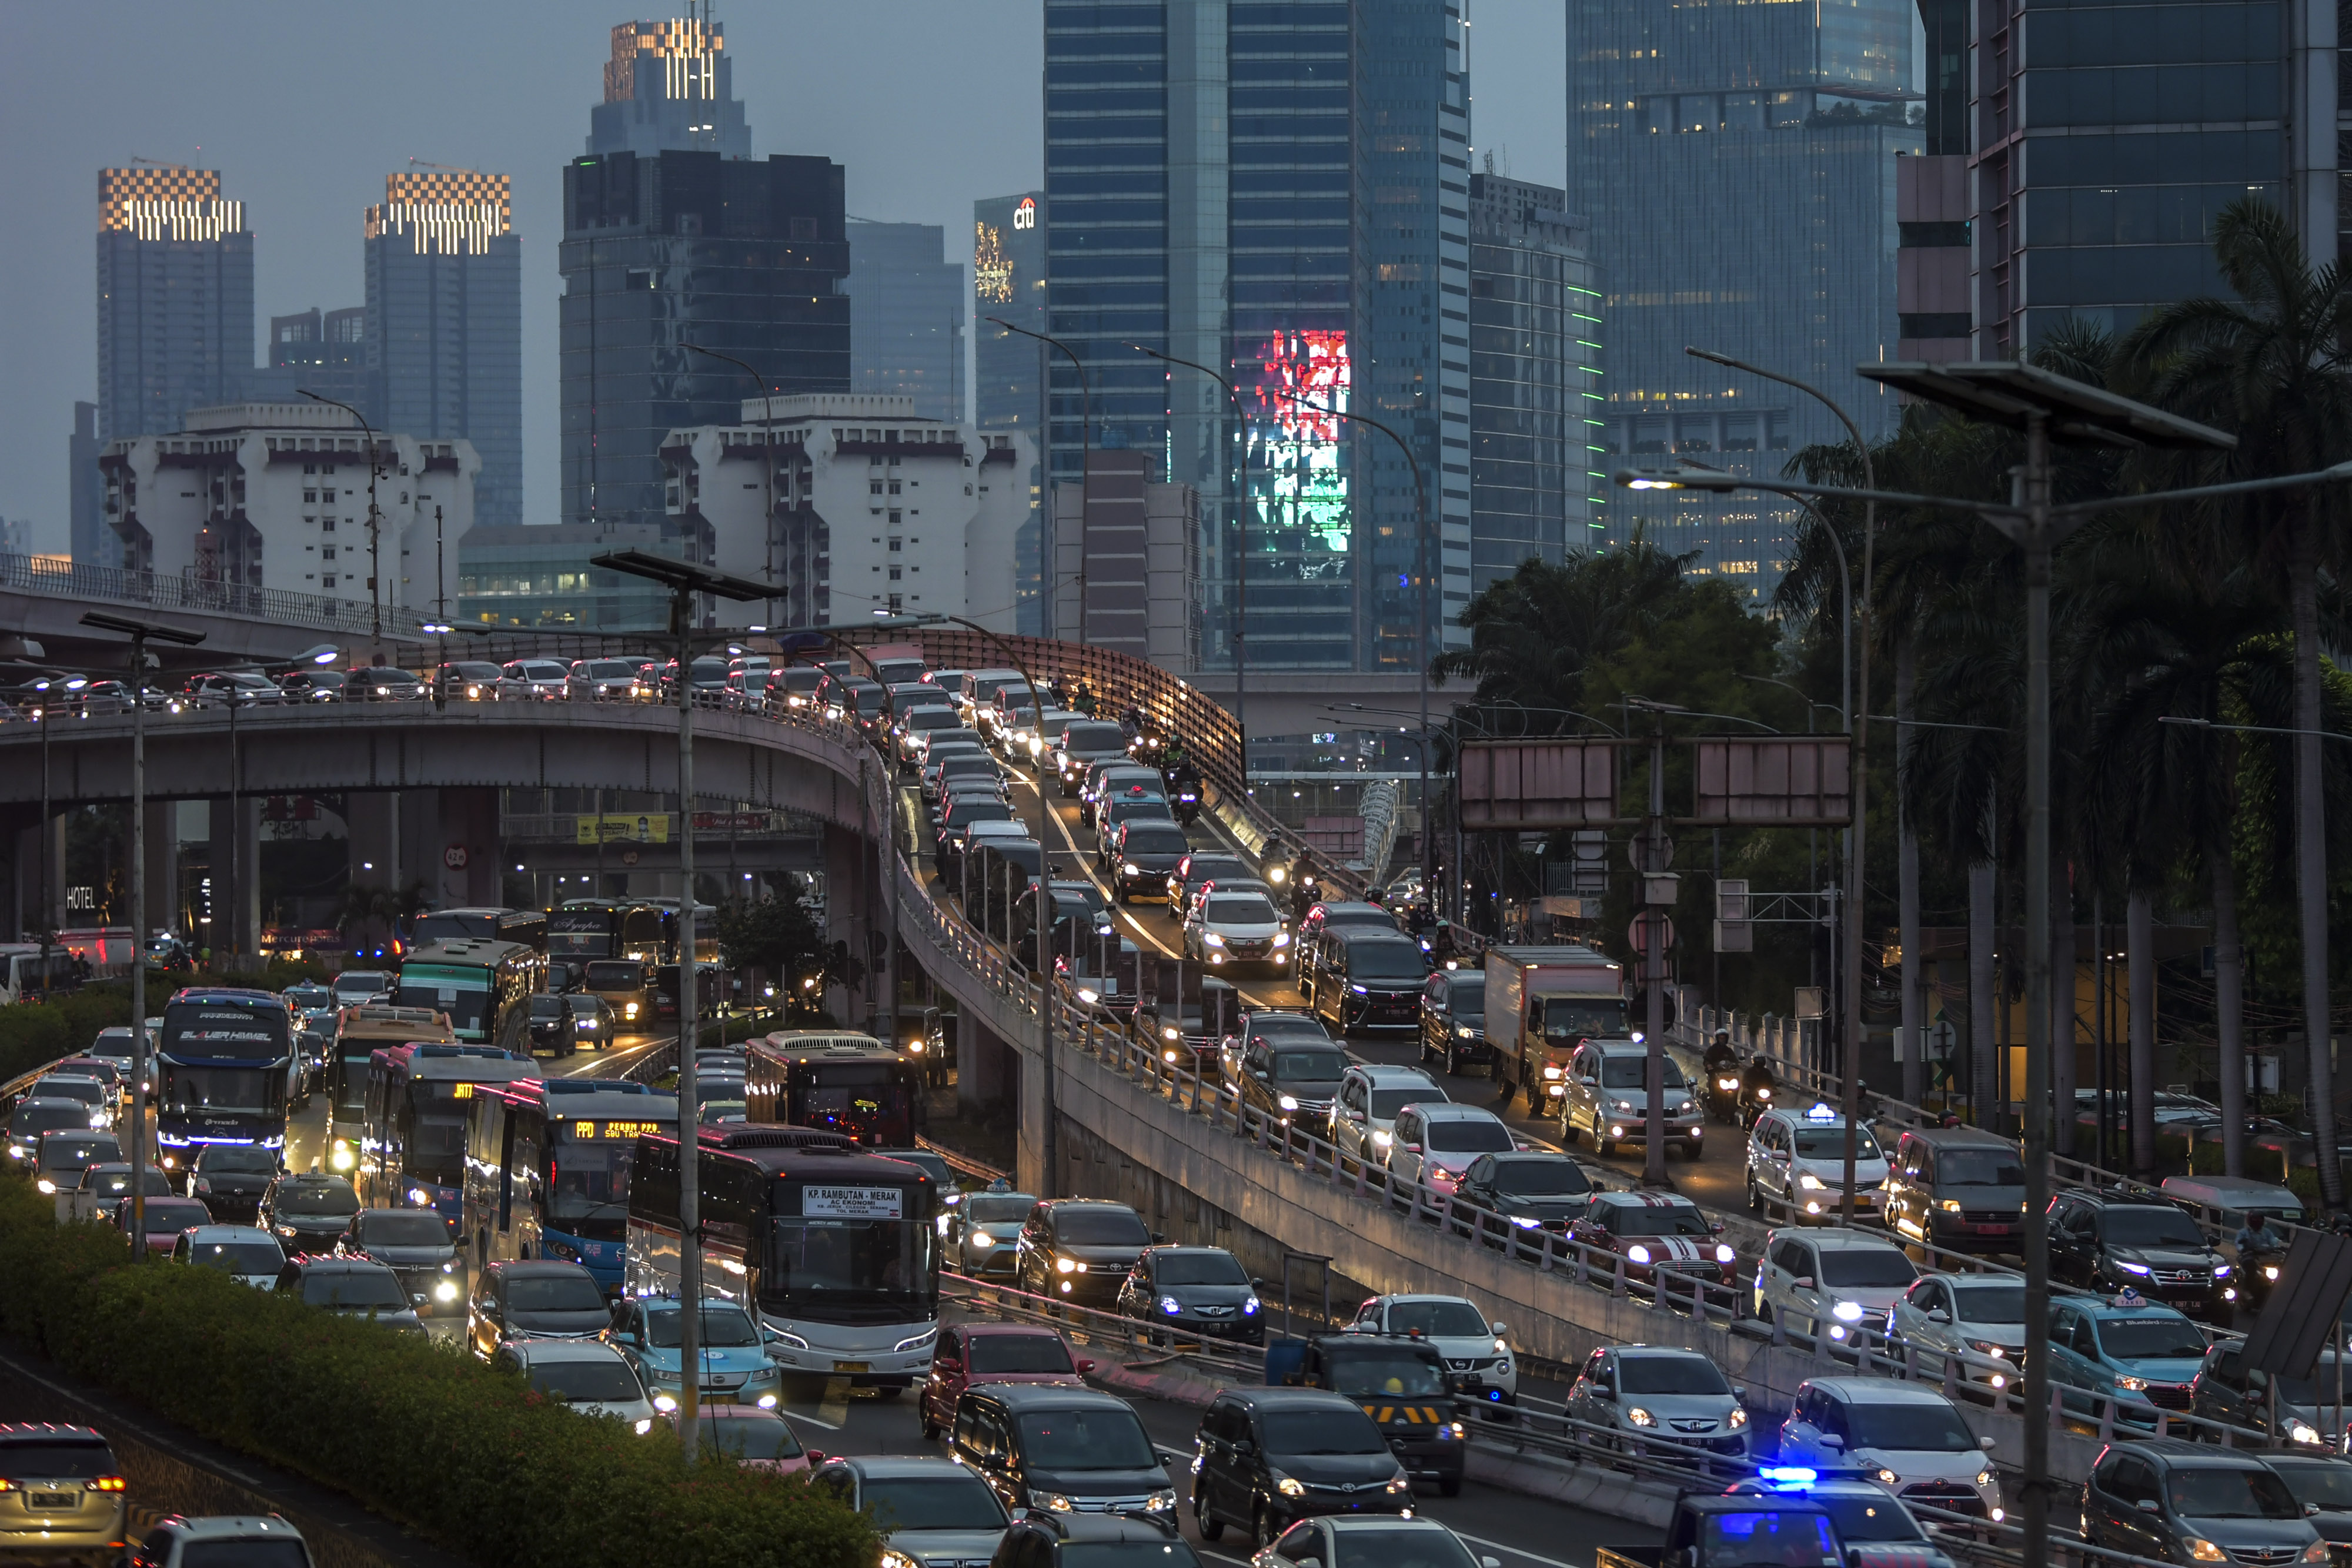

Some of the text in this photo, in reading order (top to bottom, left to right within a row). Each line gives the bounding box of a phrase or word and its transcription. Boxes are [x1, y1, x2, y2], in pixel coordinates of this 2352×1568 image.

[1014, 202, 1034, 229] citi
[67, 887, 95, 910] HOTEL
[261, 935, 309, 944] Mercure
[576, 1121, 657, 1138] PPD PERUM PPD
[605, 1129, 620, 1138] SBU
[808, 1189, 819, 1199] KP.
[823, 1189, 863, 1200] RAMBUTAN
[870, 1191, 897, 1201] MERAK
